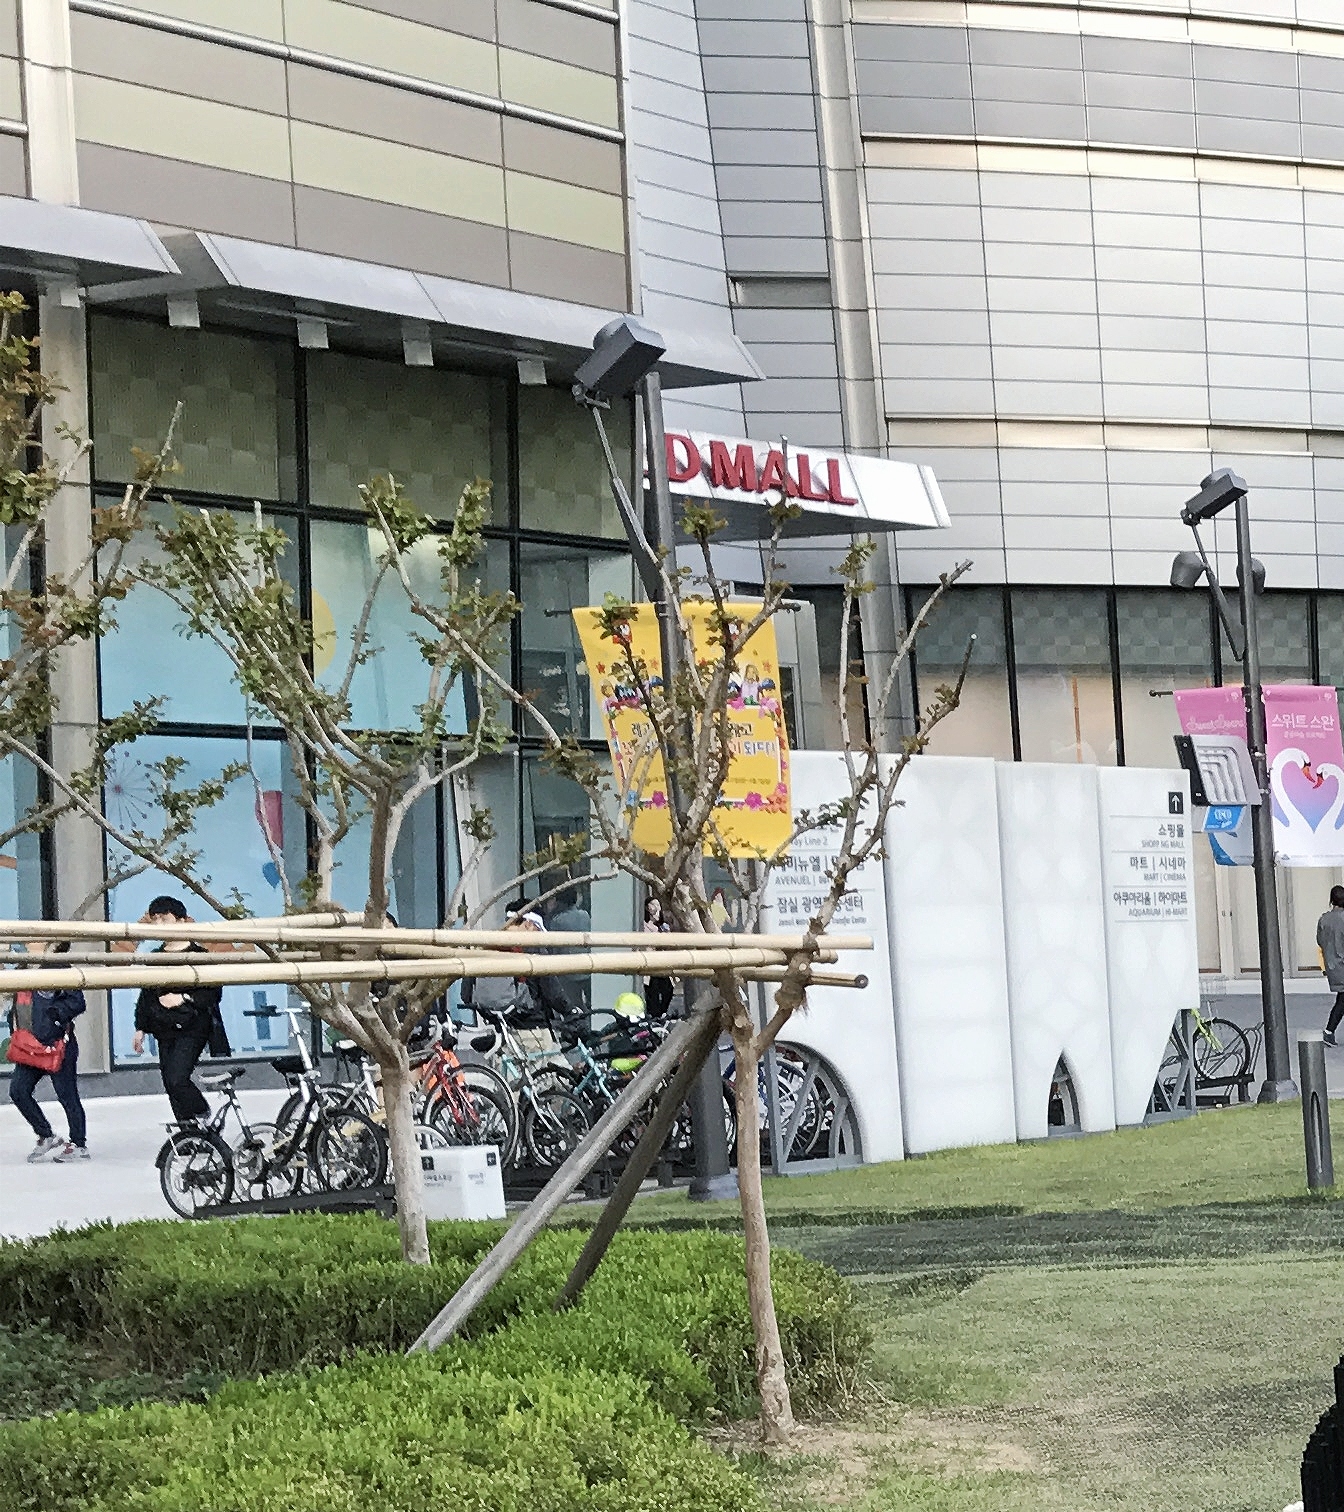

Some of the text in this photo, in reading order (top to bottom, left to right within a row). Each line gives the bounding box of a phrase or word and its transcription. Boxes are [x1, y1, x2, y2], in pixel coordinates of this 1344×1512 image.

[709, 439, 859, 506] MALL
[1271, 713, 1335, 731] 스위트 스완
[1158, 823, 1185, 838] 쇼핑몰
[1141, 839, 1169, 848] SHOPPNG
[1129, 856, 1187, 871] 마트 시네마
[775, 875, 811, 885] AVENUEL
[1143, 872, 1187, 881] MART CINEMA
[777, 896, 798, 914] 잠실
[1113, 891, 1188, 906] 아쿠아리움 하이마트
